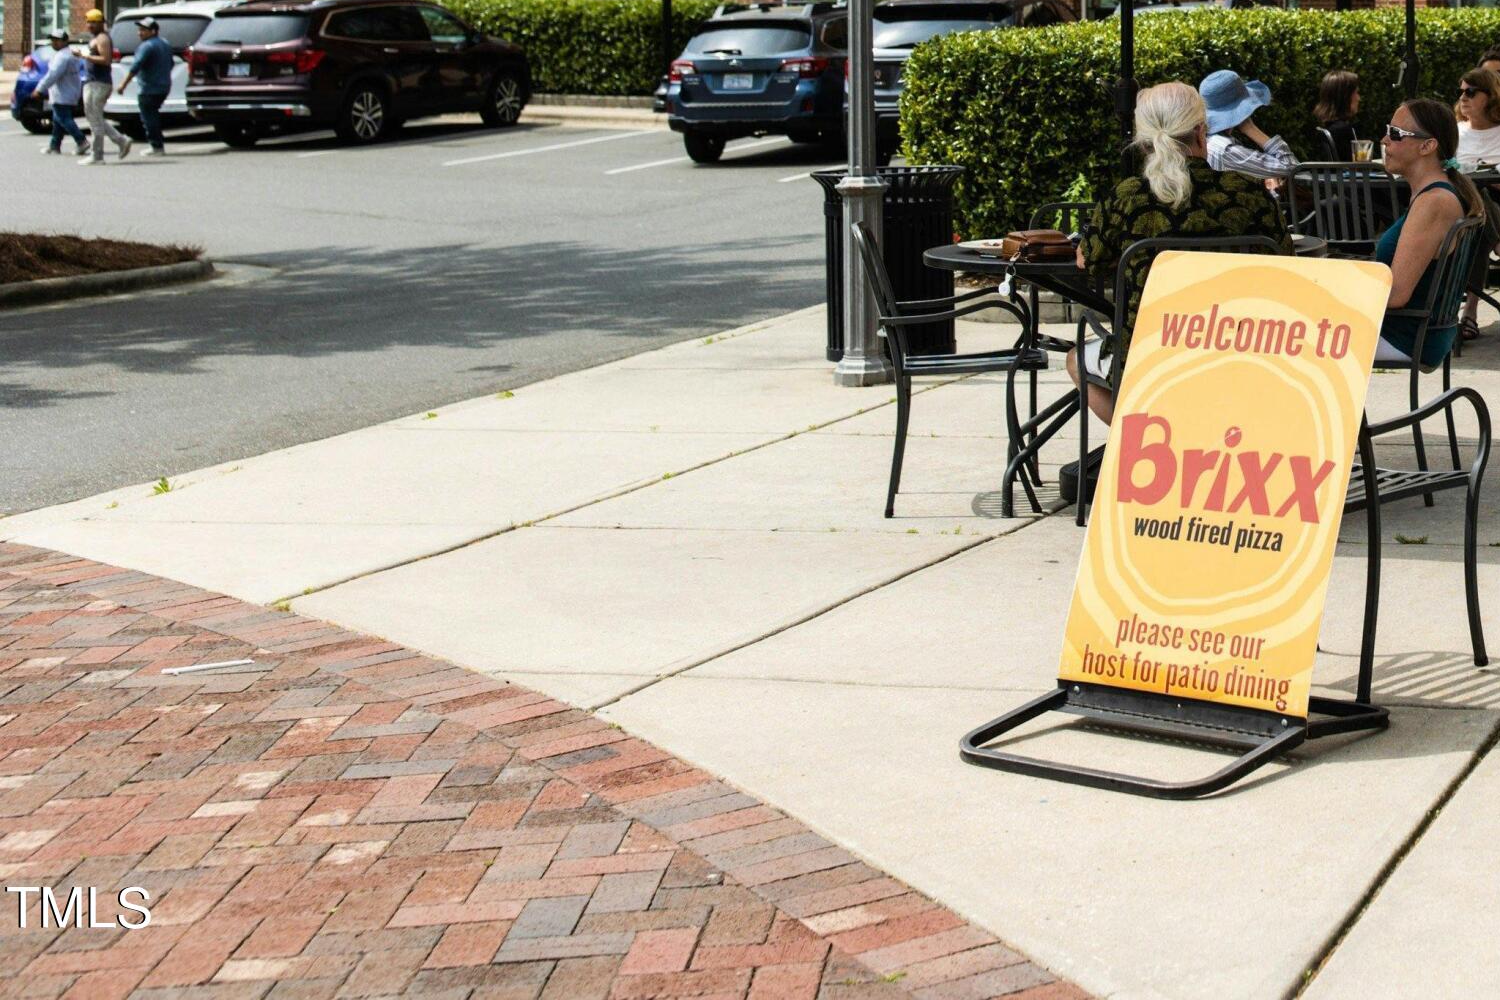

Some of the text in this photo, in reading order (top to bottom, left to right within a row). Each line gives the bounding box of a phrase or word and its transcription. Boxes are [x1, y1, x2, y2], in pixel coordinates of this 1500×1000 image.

[1161, 303, 1351, 360] welcome to
[1117, 412, 1337, 524] Brixx
[1134, 515, 1284, 553] wood fired pizza
[1115, 613, 1266, 660] please see our
[1082, 643, 1292, 712] host for patio dining
